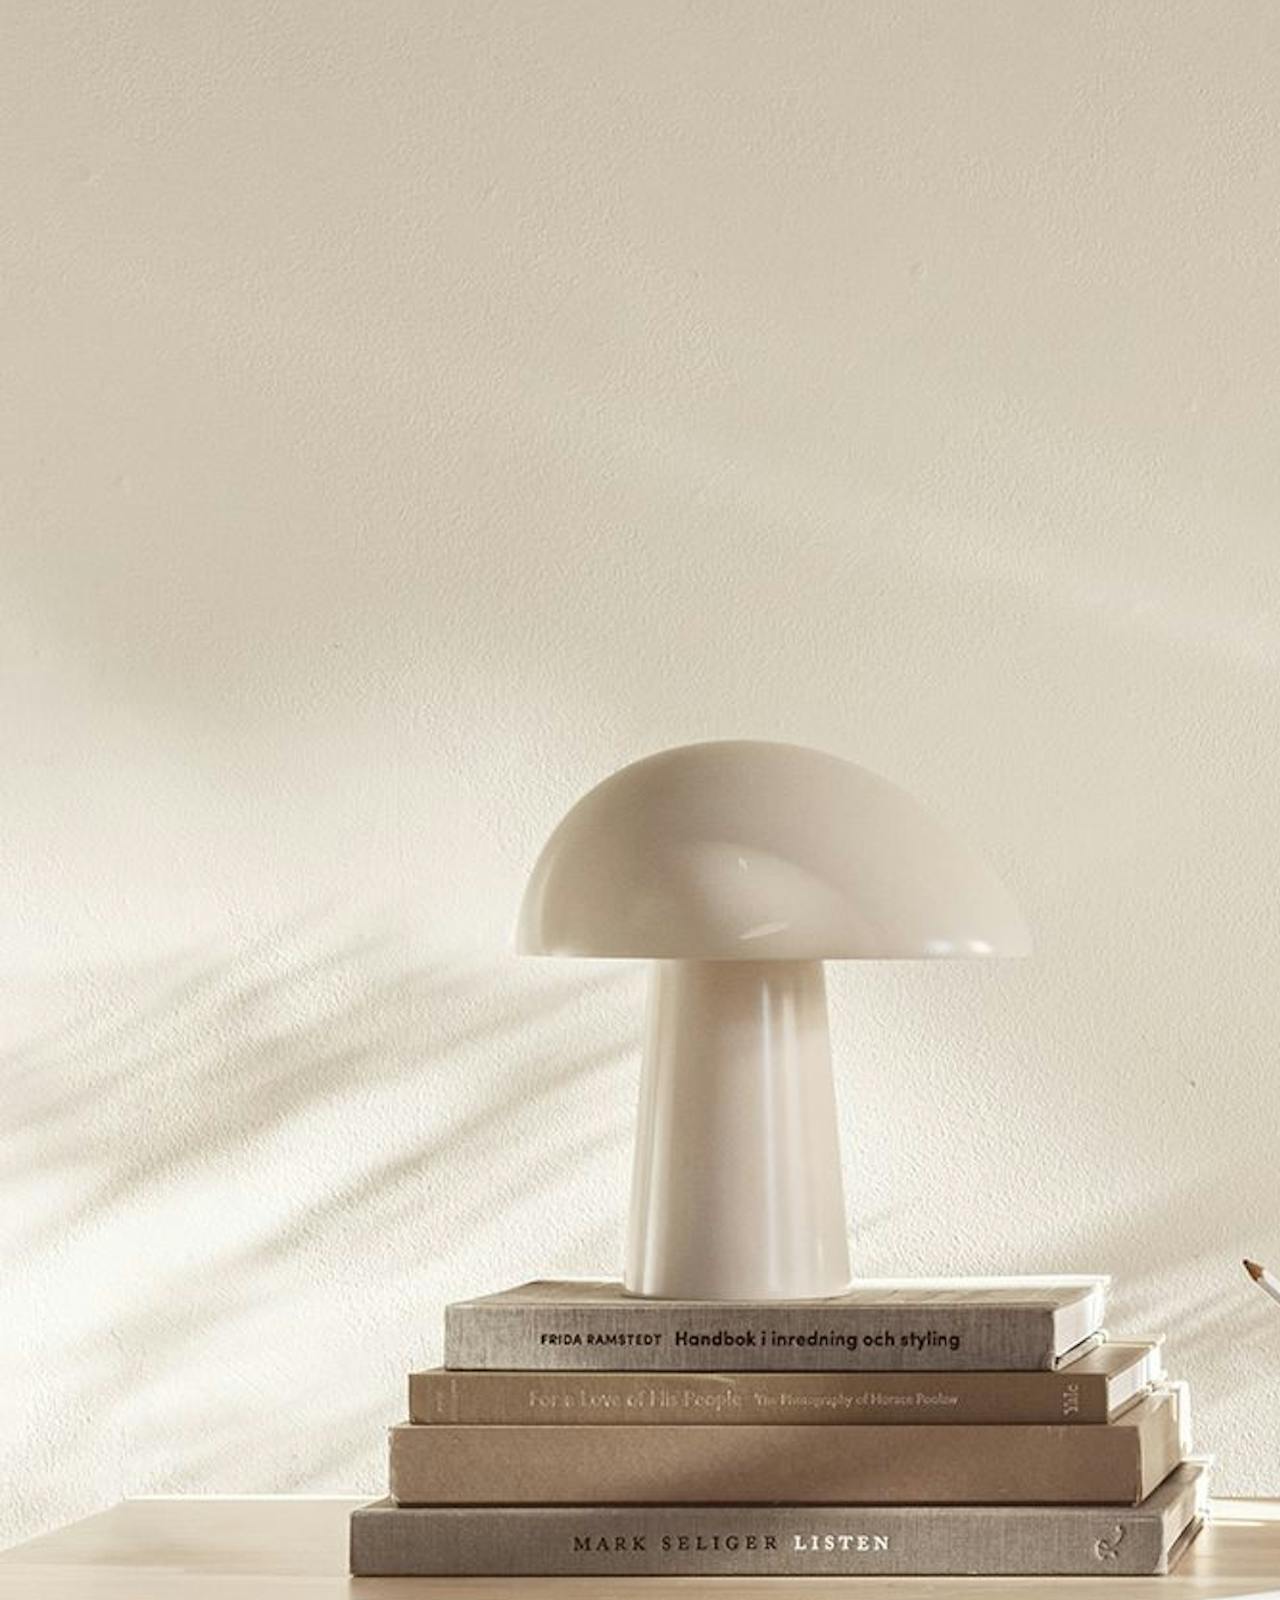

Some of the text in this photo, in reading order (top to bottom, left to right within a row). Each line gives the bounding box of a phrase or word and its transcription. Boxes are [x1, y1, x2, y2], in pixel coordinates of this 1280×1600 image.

[540, 1331, 960, 1350] FRIDA RAMSTEDT Handbok i inredning och styling
[573, 1535, 891, 1551] MARK SELIGER LISTEN
